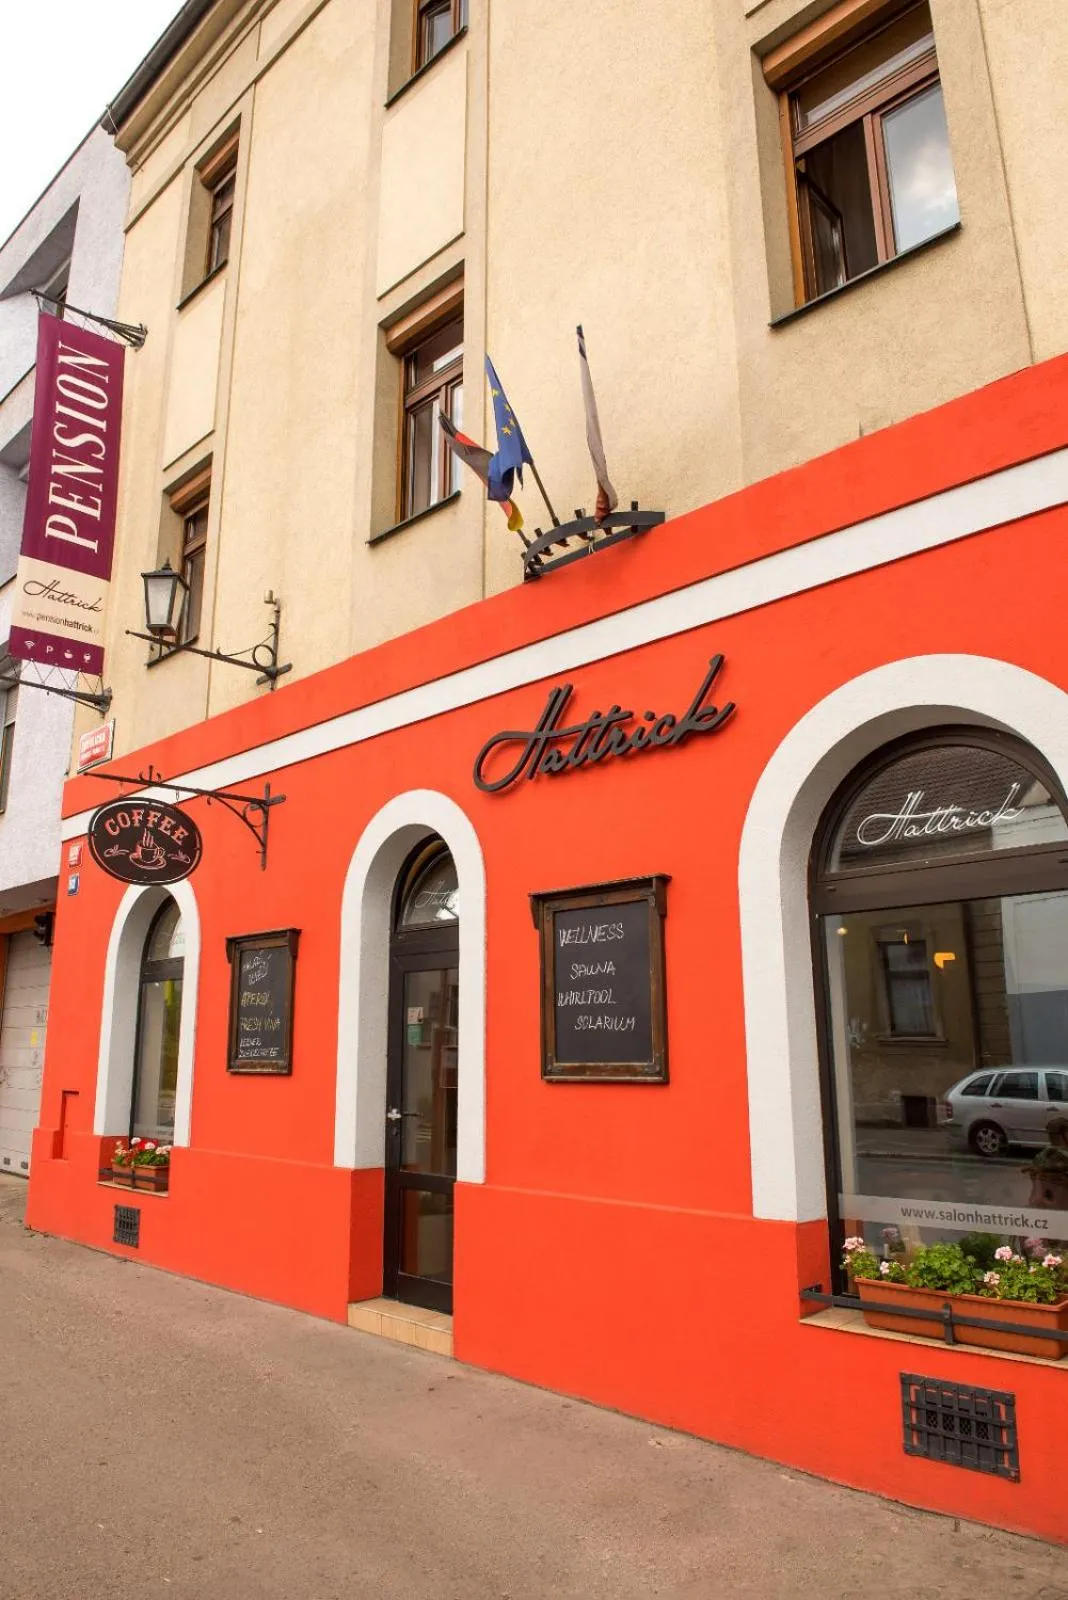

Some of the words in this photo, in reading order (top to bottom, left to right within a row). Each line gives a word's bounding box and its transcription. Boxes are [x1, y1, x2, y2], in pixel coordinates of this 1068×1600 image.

[45, 341, 110, 554] PENSION
[22, 579, 103, 613] Hattrick
[473, 653, 737, 793] Hattrick
[104, 808, 190, 846] COFFEE
[857, 782, 1025, 846] Hattrick
[559, 922, 625, 947] WELLNESS
[570, 960, 616, 980] SAUNA
[574, 1015, 635, 1031] SOLARIUM
[901, 1206, 1048, 1230] www.salonhattrick.cz
